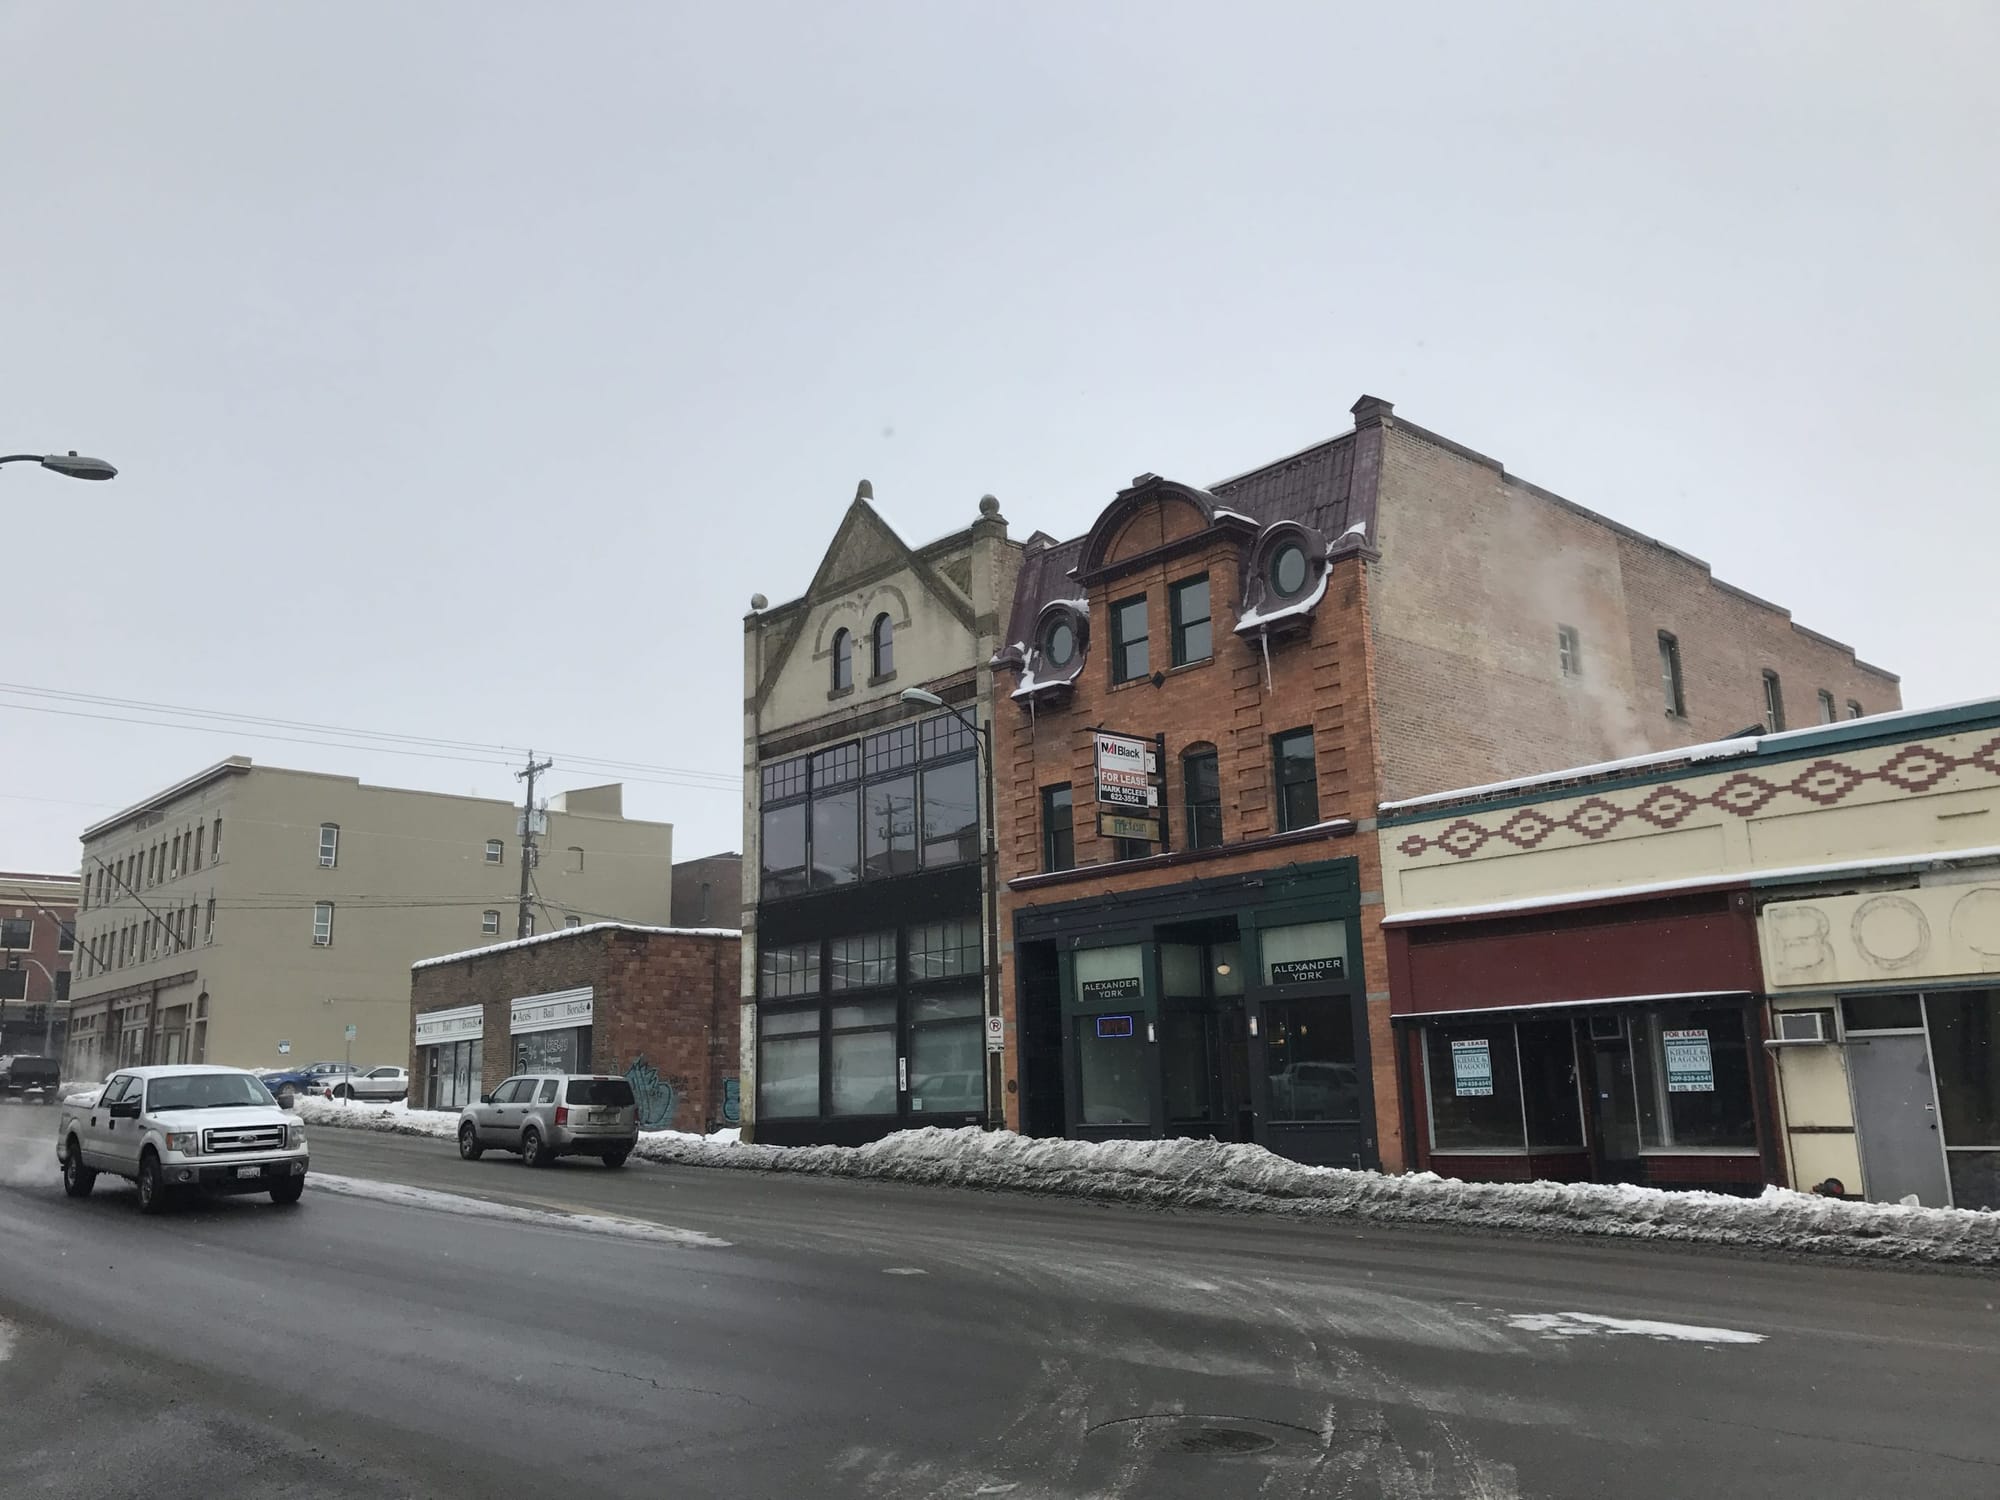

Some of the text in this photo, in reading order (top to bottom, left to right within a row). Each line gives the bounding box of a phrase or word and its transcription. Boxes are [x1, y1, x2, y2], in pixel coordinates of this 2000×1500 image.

[1101, 742, 1117, 755] NAI
[1118, 745, 1140, 759] Black
[1102, 771, 1146, 786] FOR LEASE
[1101, 784, 1121, 793] MARK
[1122, 787, 1147, 797] MCLEES
[1274, 960, 1341, 973] ALEXANDER
[1292, 971, 1323, 980] YORK
[1084, 979, 1138, 991] ALEXANDER
[1099, 989, 1123, 998] YORK
[543, 1007, 554, 1019] Bail
[567, 1003, 586, 1015] Bonds
[1670, 1048, 1697, 1056] KIEMLE
[1670, 1055, 1709, 1063] HAGOOD
[1457, 1062, 1489, 1070] HAGOOD
